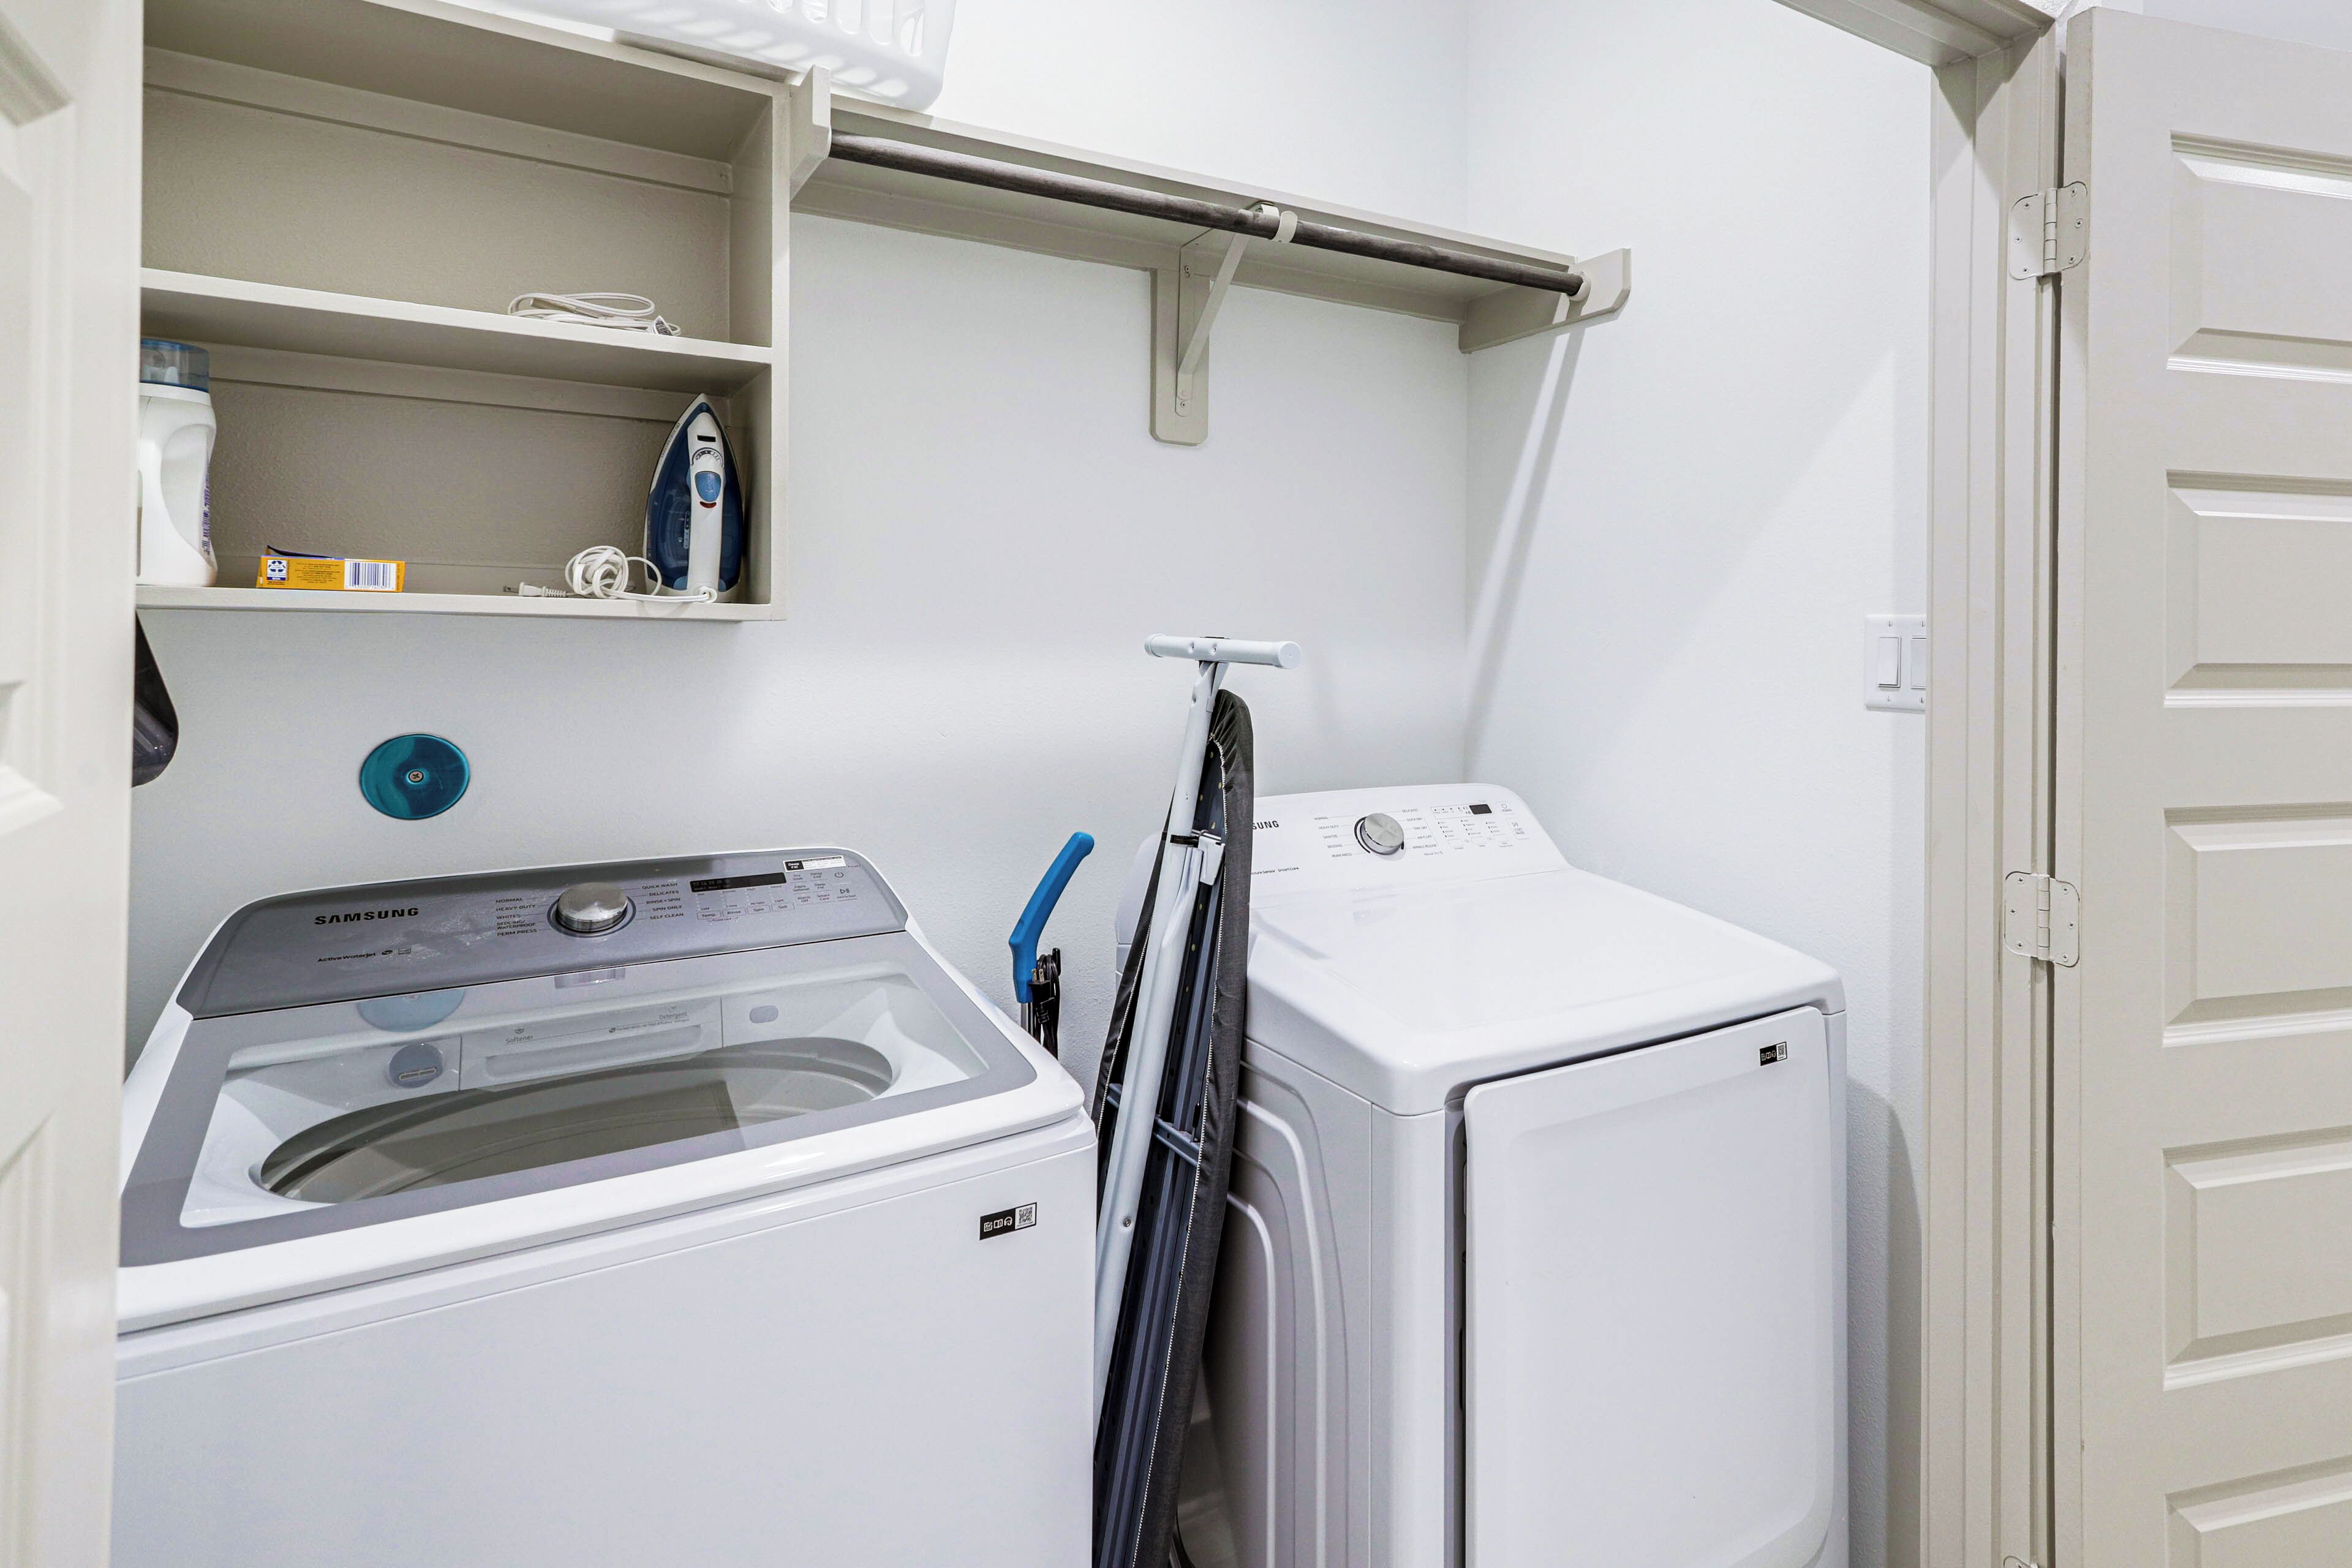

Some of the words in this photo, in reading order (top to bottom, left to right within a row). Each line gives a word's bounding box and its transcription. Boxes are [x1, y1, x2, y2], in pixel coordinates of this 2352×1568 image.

[1252, 820, 1279, 830] SUNG
[314, 907, 419, 925] SAMSUNG
[505, 1035, 533, 1045] Softener
